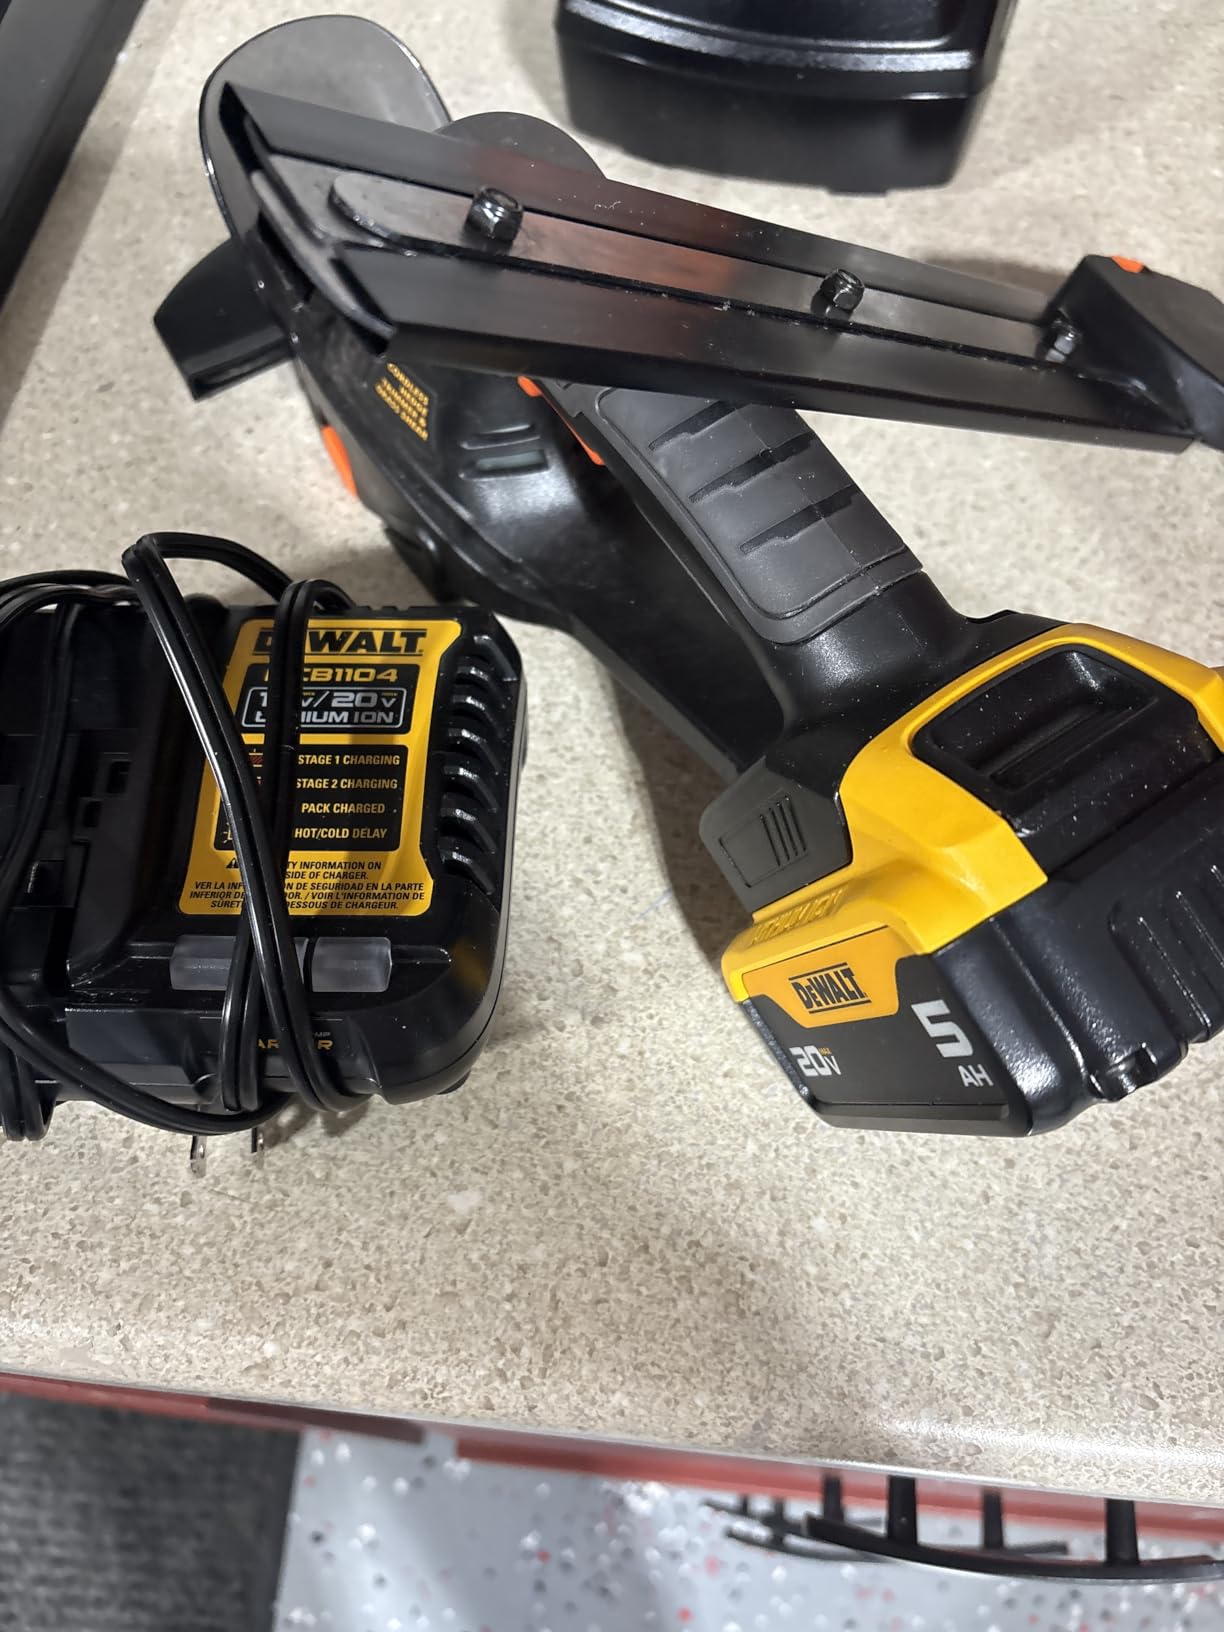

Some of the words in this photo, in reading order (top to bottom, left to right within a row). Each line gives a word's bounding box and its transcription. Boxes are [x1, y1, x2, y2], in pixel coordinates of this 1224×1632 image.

[251, 629, 427, 655] DWALT
[264, 668, 399, 683] B1104
[254, 710, 348, 723] LIUM
[353, 710, 394, 723] ION
[297, 754, 331, 766] STAGE
[334, 754, 340, 765] 1
[343, 754, 400, 766] CHARGING
[296, 778, 330, 789] STAGE
[331, 778, 338, 789] 2
[340, 778, 398, 790] CHARGING
[301, 803, 330, 814] PACK
[333, 803, 385, 814] CHARGED
[294, 827, 350, 840] HOT/COLD
[352, 827, 387, 839] DELAY
[299, 861, 366, 871] INFORMATION
[368, 861, 382, 870] ON
[307, 870, 320, 880] OF
[322, 871, 369, 880] CHARGER.
[195, 881, 213, 891] VER
[214, 881, 226, 891] LA
[296, 882, 309, 891] DE
[310, 882, 364, 891] SEGURIDAD
[366, 882, 379, 891] EN
[381, 882, 393, 891] LA
[394, 882, 424, 892] PARTE
[189, 890, 232, 900] INFERIOR
[311, 891, 333, 900] VOIR
[335, 891, 410, 901] L'INFORMATION
[412, 892, 425, 901] DE
[330, 901, 343, 910] DE
[345, 901, 399, 910] CHARGEUR.
[790, 965, 868, 1010] DEWALT
[911, 999, 974, 1058] 5
[957, 1063, 994, 1087] AH
